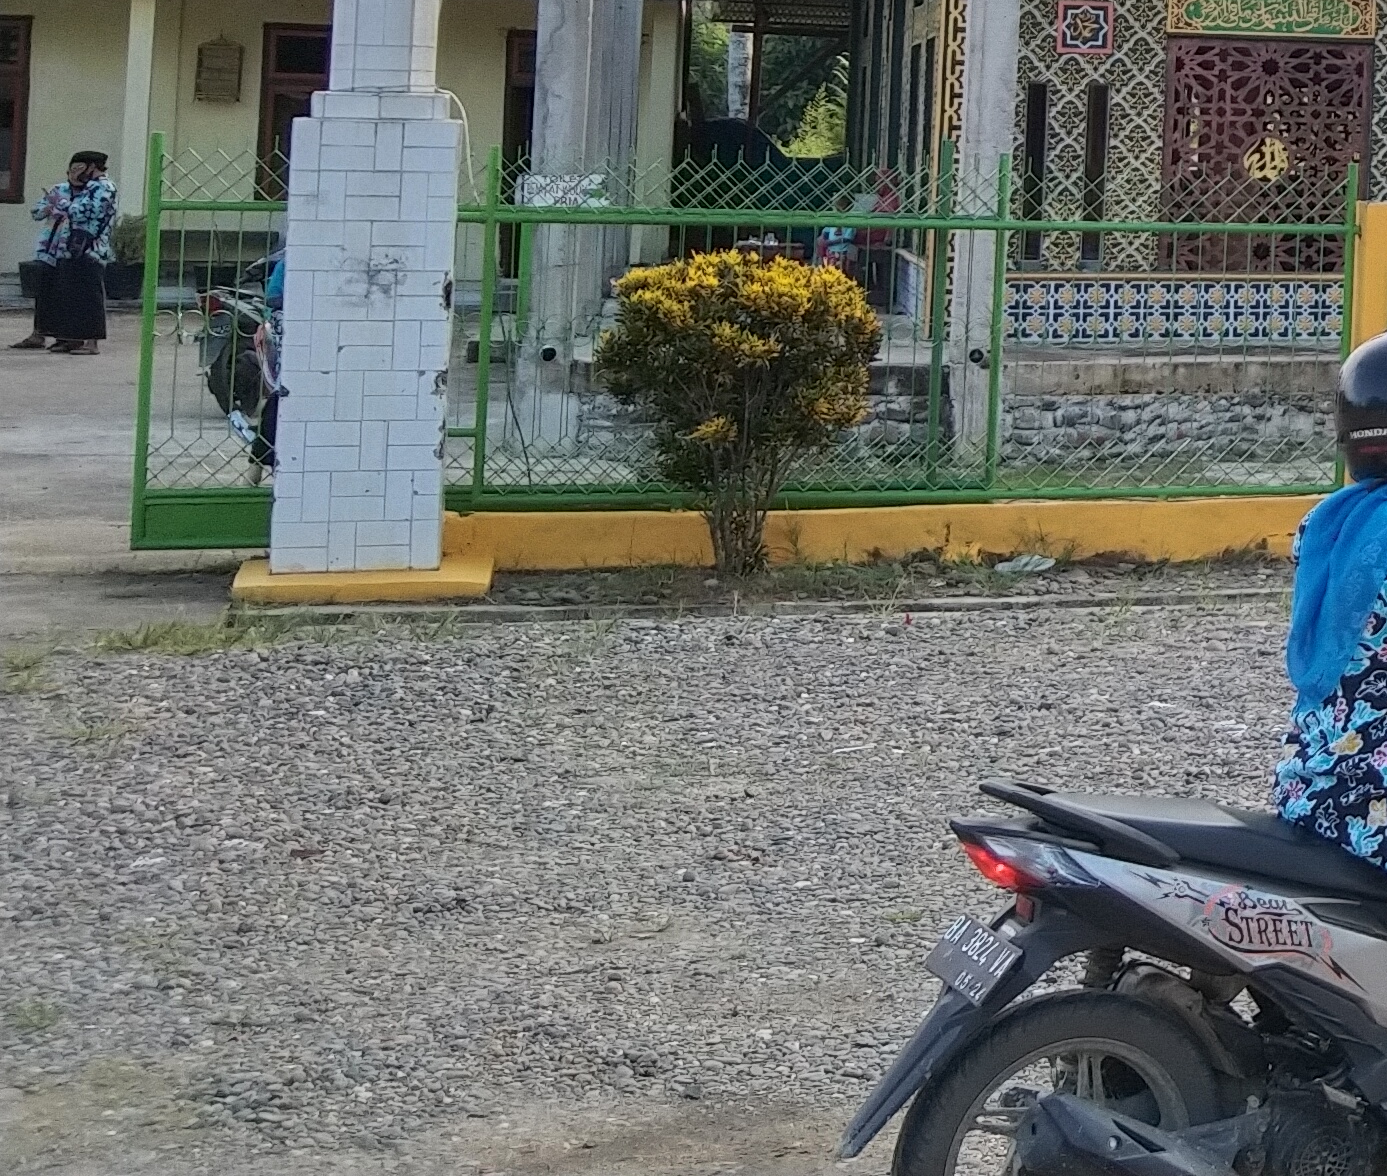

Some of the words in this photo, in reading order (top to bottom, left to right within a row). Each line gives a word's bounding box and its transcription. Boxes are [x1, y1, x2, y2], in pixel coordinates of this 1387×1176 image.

[943, 915, 972, 944] BA
[961, 927, 1000, 966] 3824
[988, 947, 1016, 978] VA
[1222, 907, 1312, 947] STREET
